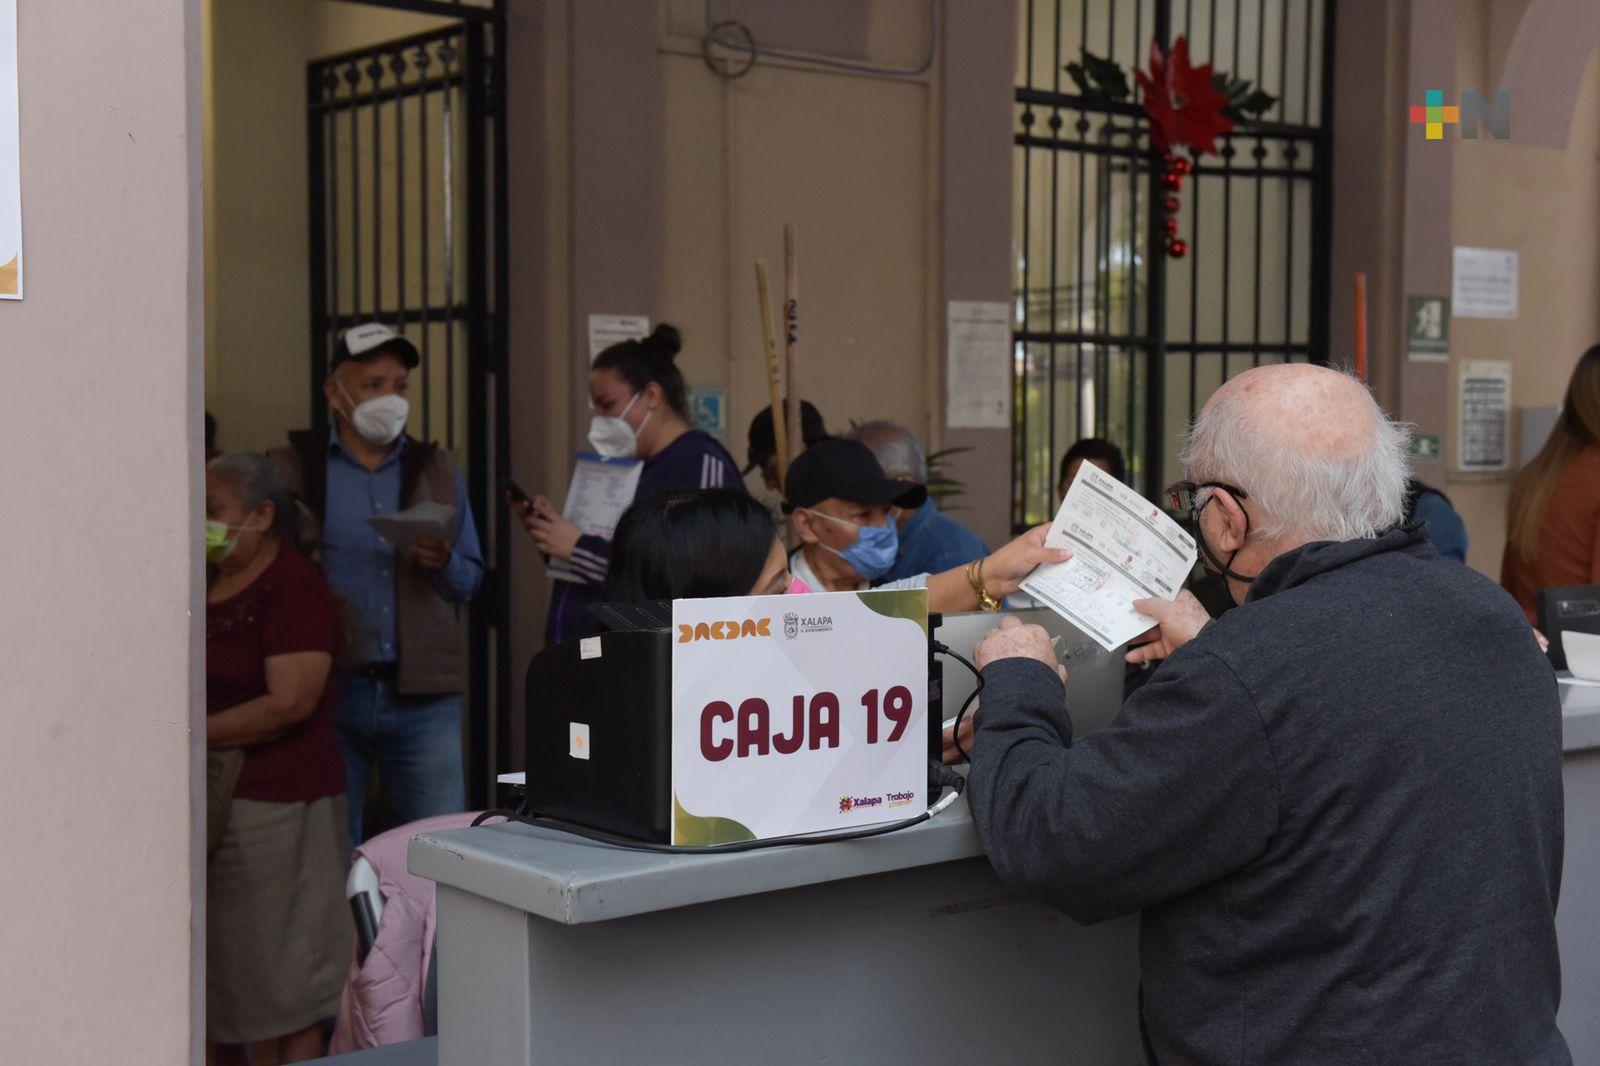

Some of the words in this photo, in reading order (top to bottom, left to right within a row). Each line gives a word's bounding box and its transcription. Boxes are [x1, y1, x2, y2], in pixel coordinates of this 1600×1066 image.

[801, 616, 832, 626] XALAPA
[700, 691, 840, 762] CAJA
[861, 685, 913, 744] 19
[886, 791, 915, 801] Trabajo
[853, 797, 882, 806] Xalapa
